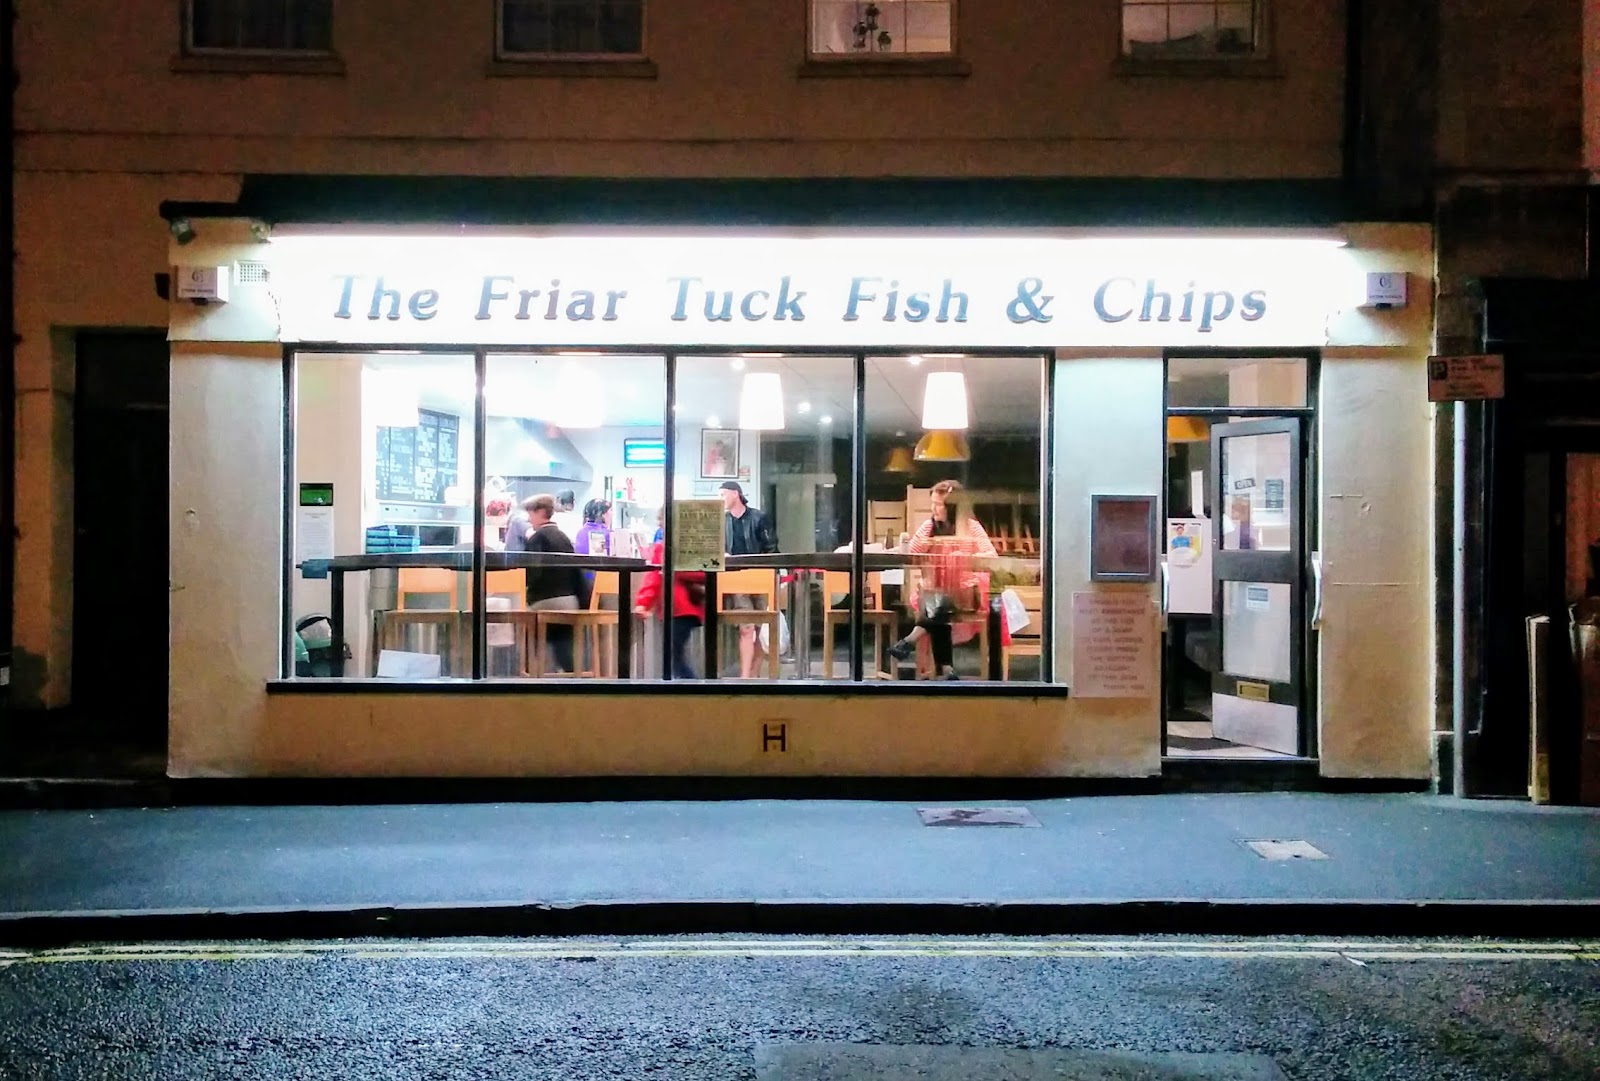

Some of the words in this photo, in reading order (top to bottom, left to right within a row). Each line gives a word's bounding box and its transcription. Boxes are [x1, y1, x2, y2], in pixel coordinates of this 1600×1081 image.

[331, 275, 440, 321] The
[474, 275, 628, 321] Friar
[667, 275, 808, 322] Tuck
[841, 276, 969, 323] Fish
[1005, 277, 1054, 323] &
[1093, 277, 1267, 333] Chips
[1236, 479, 1253, 488] OPEN
[763, 723, 786, 752] H
